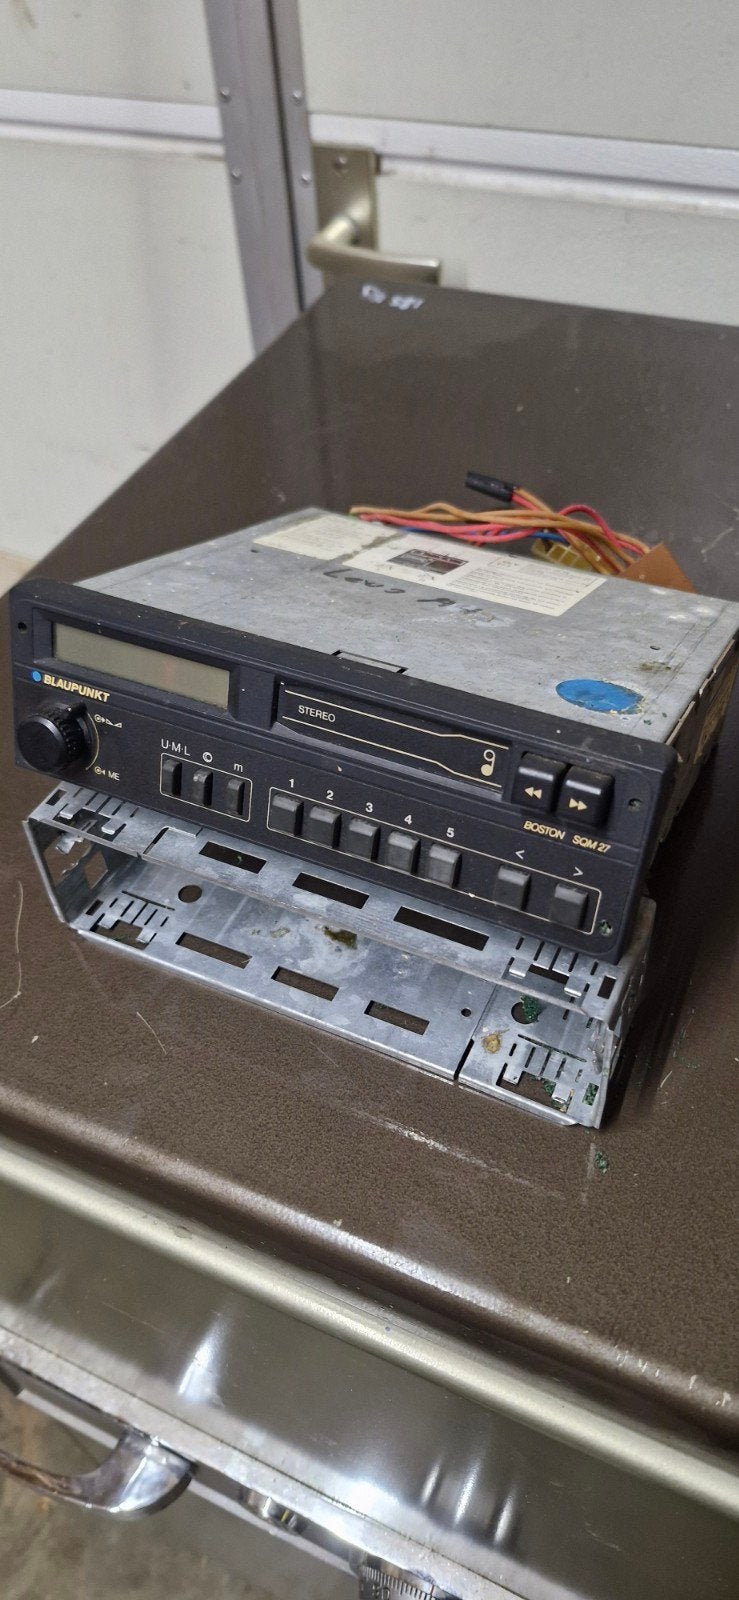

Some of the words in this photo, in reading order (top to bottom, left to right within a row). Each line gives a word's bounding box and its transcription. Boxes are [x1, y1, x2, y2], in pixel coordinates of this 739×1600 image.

[43, 674, 110, 702] BLAUPUNKT
[298, 704, 336, 722] STEREO
[108, 770, 120, 781] ME
[233, 763, 244, 773] m
[289, 778, 295, 788] 1
[326, 790, 334, 800] 2
[365, 802, 374, 813] 3
[404, 815, 412, 825] 4
[446, 827, 455, 838] 5
[523, 820, 566, 840] BOSTON
[572, 834, 598, 850] SQM
[597, 843, 612, 853] 27
